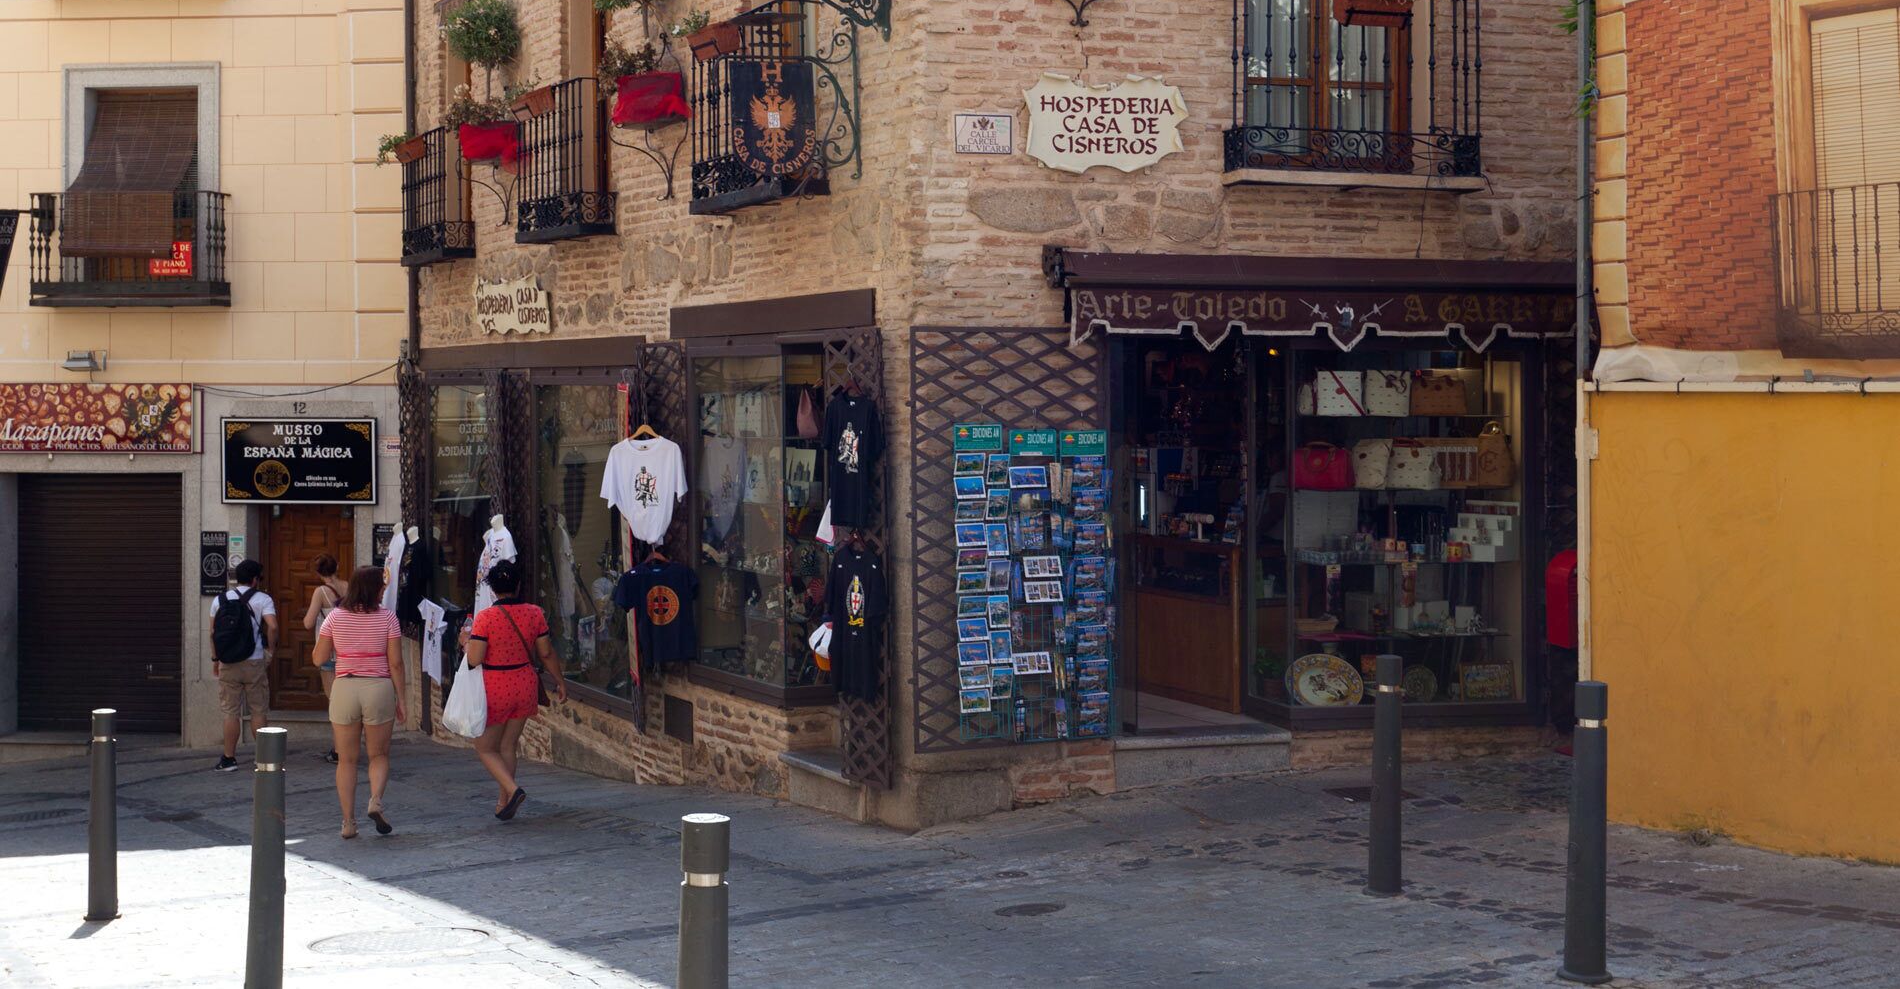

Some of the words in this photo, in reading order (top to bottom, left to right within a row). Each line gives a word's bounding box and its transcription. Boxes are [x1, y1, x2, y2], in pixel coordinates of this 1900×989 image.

[761, 62, 783, 82] H
[1040, 95, 1175, 115] HOSPEDERIA
[1062, 114, 1121, 134] CASA
[1133, 117, 1160, 135] DE
[970, 130, 997, 138] CALLE
[733, 127, 750, 162] CASA
[750, 158, 767, 172] DE
[772, 129, 816, 174] CISNEROS
[957, 144, 971, 152] DEL
[976, 145, 1010, 153] VICARIO
[1052, 134, 1158, 155] CISNEROS
[516, 287, 532, 305] CASA
[476, 292, 515, 315] HOSPEDERIA
[518, 307, 547, 324] CISNEROS
[293, 401, 307, 414] 12
[273, 424, 323, 436] MUSEO
[972, 427, 993, 438] EDICIONES
[284, 436, 297, 445] DE
[298, 436, 312, 445] LA
[1027, 434, 1047, 444] EDICIONES
[1078, 434, 1097, 444] EDICIONES
[243, 445, 296, 458] ESPAÑA
[301, 445, 353, 458] MÁGICA
